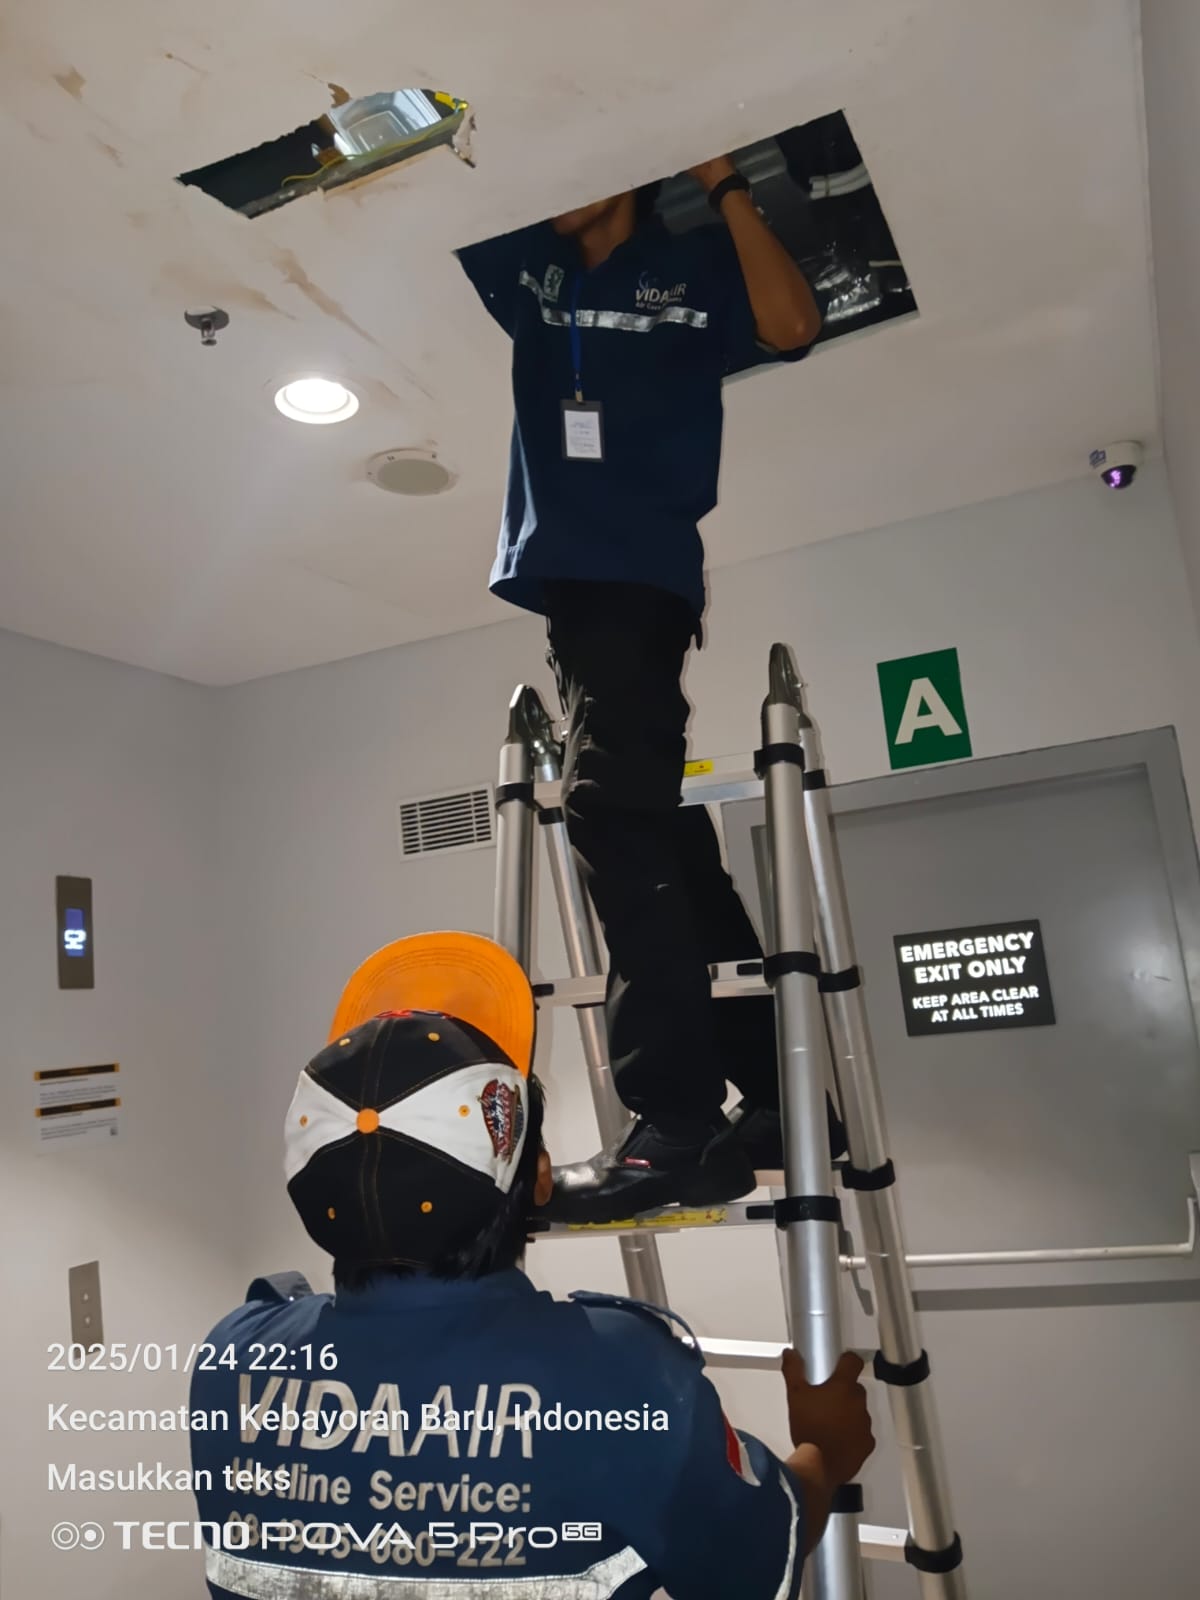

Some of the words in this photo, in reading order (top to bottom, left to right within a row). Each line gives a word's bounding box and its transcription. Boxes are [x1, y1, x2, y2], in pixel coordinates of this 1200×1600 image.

[894, 677, 963, 745] A
[900, 931, 1034, 963] EMERGENCY
[914, 963, 962, 984] EXIT
[967, 956, 1026, 978] ONLY
[912, 995, 948, 1009] KEEP
[951, 991, 990, 1006] AREA
[992, 986, 1040, 1000] CLEAR
[931, 1010, 949, 1023] AT
[952, 1008, 978, 1021] ALL
[979, 1003, 1024, 1018] TIMES
[238, 1373, 541, 1459] VIDAAIR
[369, 1470, 531, 1513] Service:
